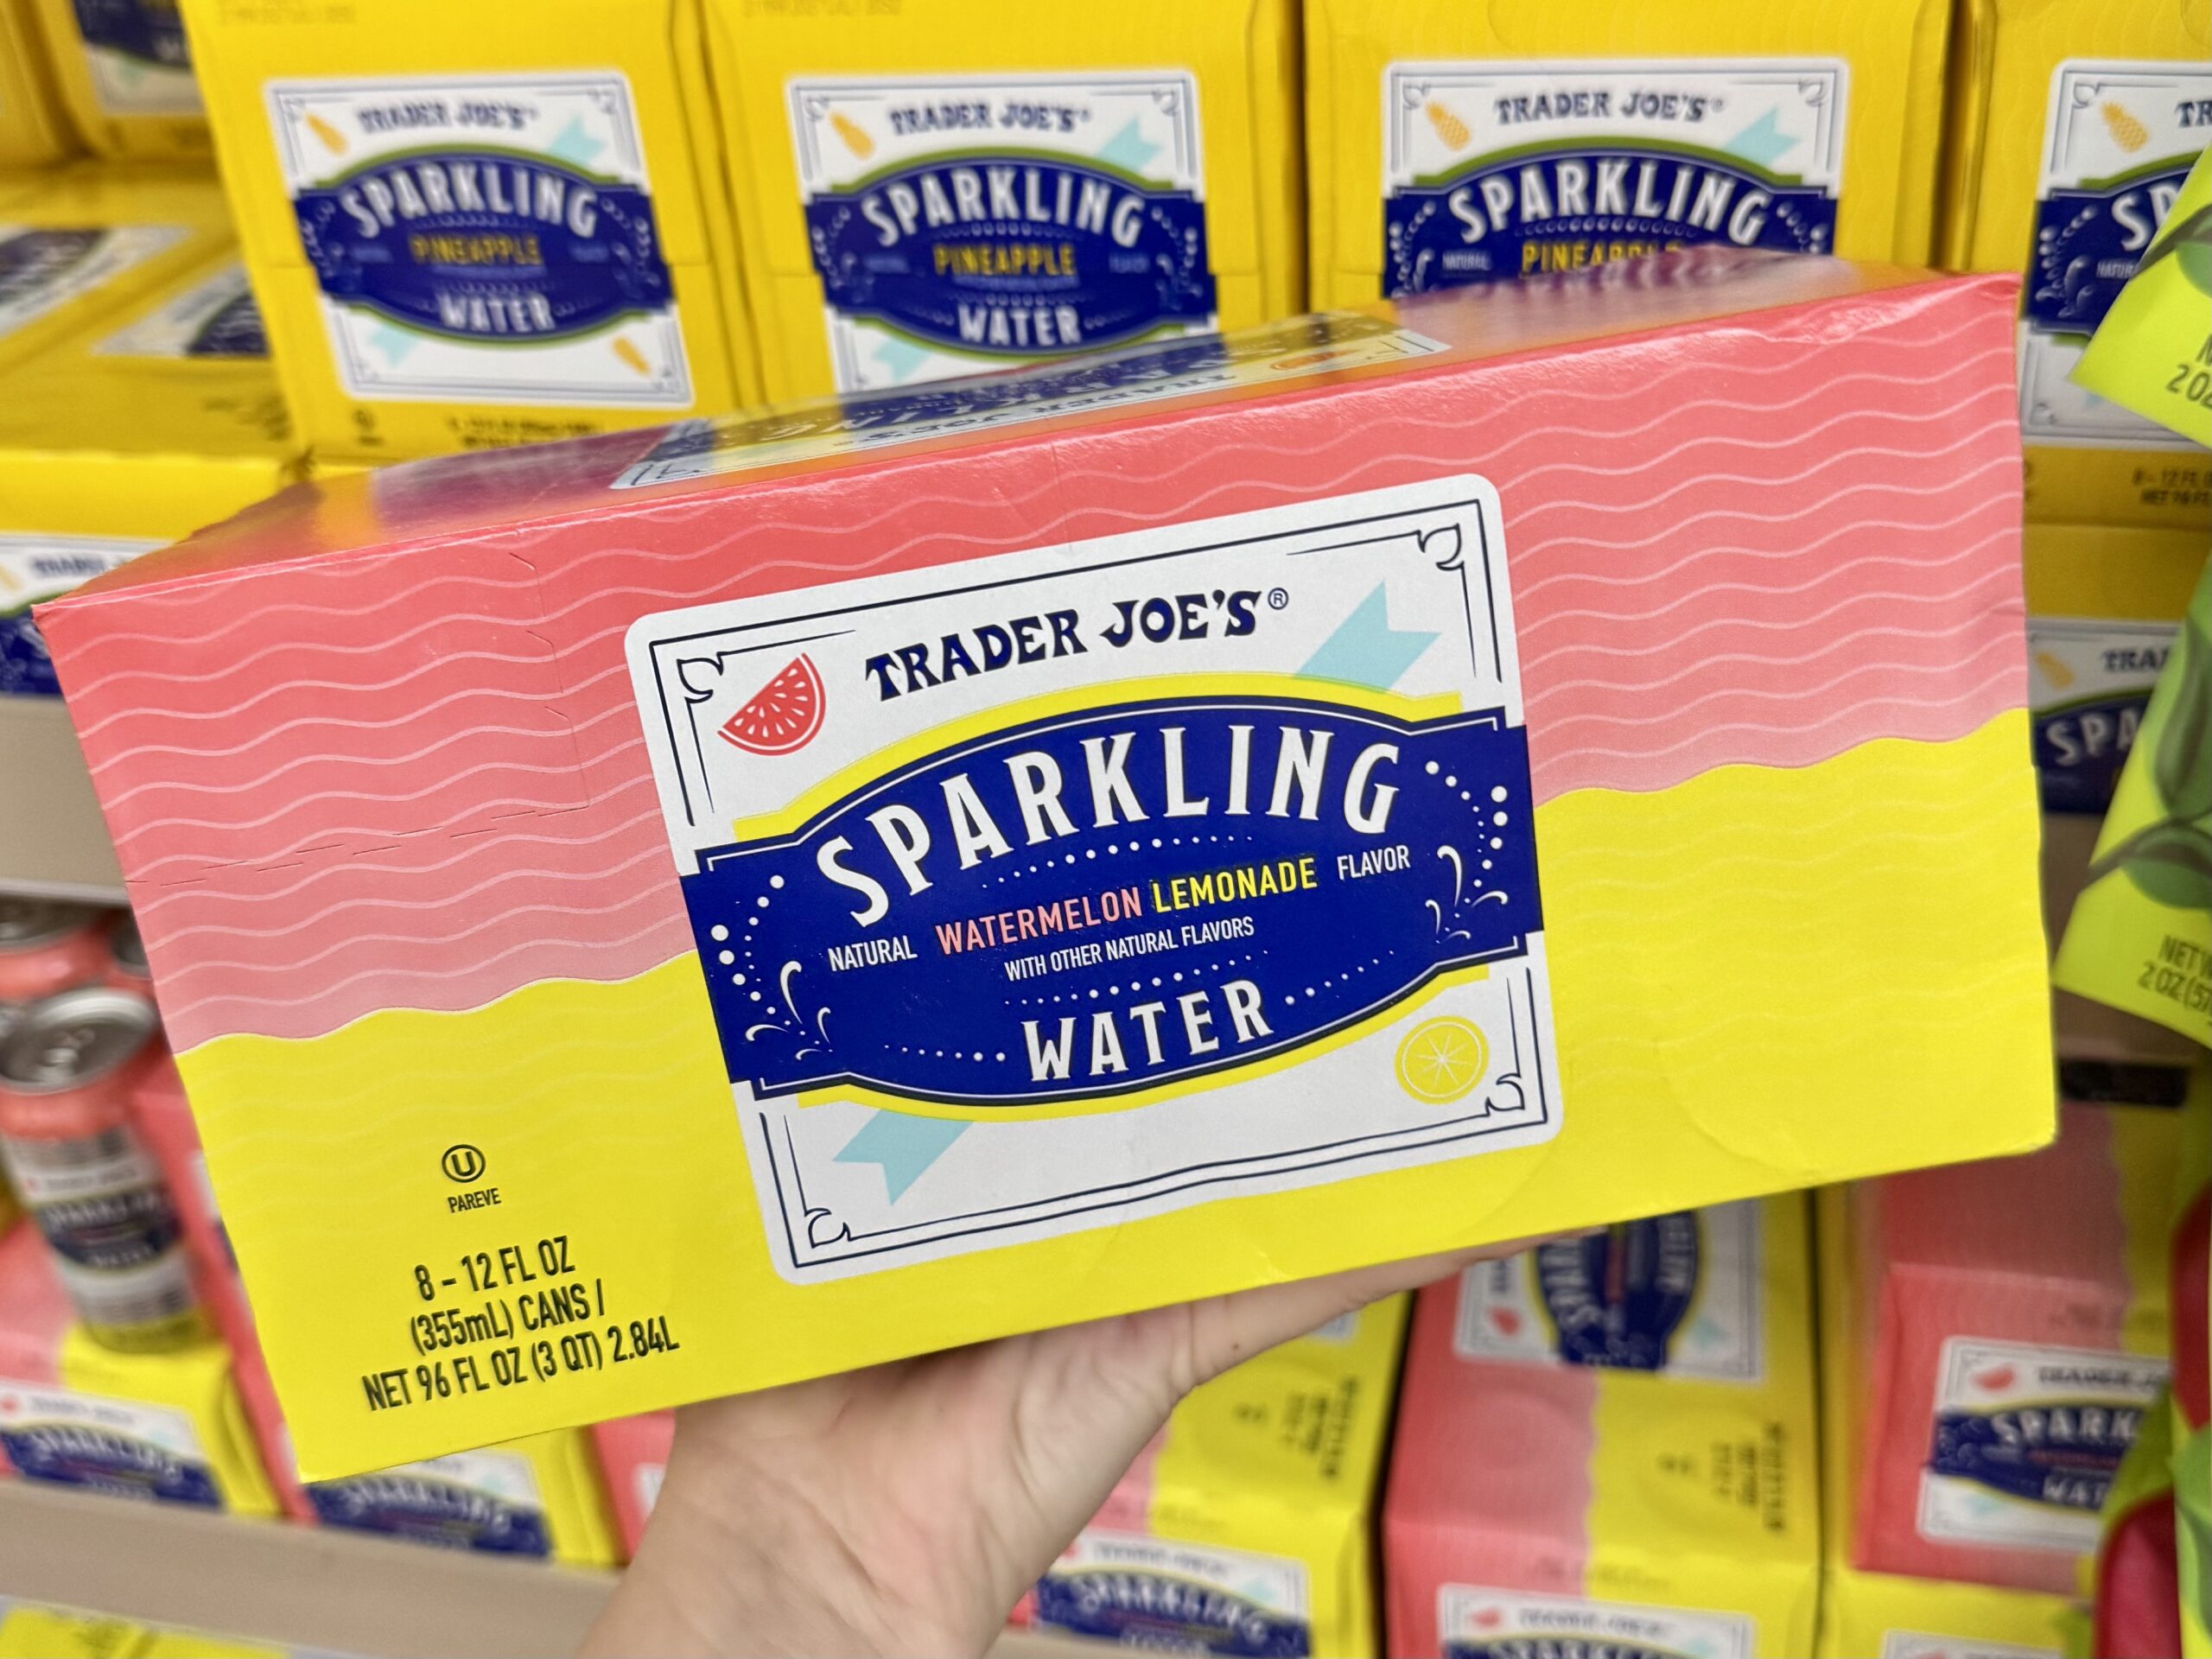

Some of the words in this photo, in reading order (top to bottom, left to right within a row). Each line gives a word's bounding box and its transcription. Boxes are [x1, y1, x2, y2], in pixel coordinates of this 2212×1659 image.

[890, 104, 992, 135] TRADER
[1494, 92, 1611, 124] TRADER
[340, 162, 597, 238] SPARKLING
[861, 167, 1146, 248] SPARKLING
[1448, 156, 1773, 246] SPARKLING
[410, 232, 543, 264] PINEAPPLE
[933, 244, 1076, 276] PINEAPPLE
[437, 291, 556, 333] WATER
[957, 304, 1081, 346] WATER
[867, 608, 1088, 702] TRADER
[817, 725, 1402, 929] SPARKLING
[828, 934, 918, 974] NATURAL
[935, 887, 1143, 957] WATERMELON
[1152, 858, 1319, 913] LEMONADE
[1337, 843, 1411, 881] FLAVOR
[1004, 954, 1047, 982] WITH
[1050, 944, 1103, 974] OTHER
[1106, 930, 1179, 965] NATURAL
[1181, 916, 1255, 952] FLAVORS
[1021, 978, 1274, 1082] WATER
[448, 1187, 501, 1213] PAREVE
[414, 1264, 435, 1301] 8
[461, 1252, 498, 1292] 12
[499, 1245, 536, 1285] FL
[537, 1236, 575, 1276] OZ
[410, 1299, 515, 1356] (355mL)
[518, 1283, 591, 1332] CANS
[362, 1369, 412, 1411] NET
[416, 1361, 452, 1401] 96
[454, 1356, 490, 1394] FL
[492, 1346, 528, 1386] OZ
[531, 1340, 557, 1382] (3
[561, 1331, 603, 1371] QT)
[607, 1315, 680, 1363] 2.84L
